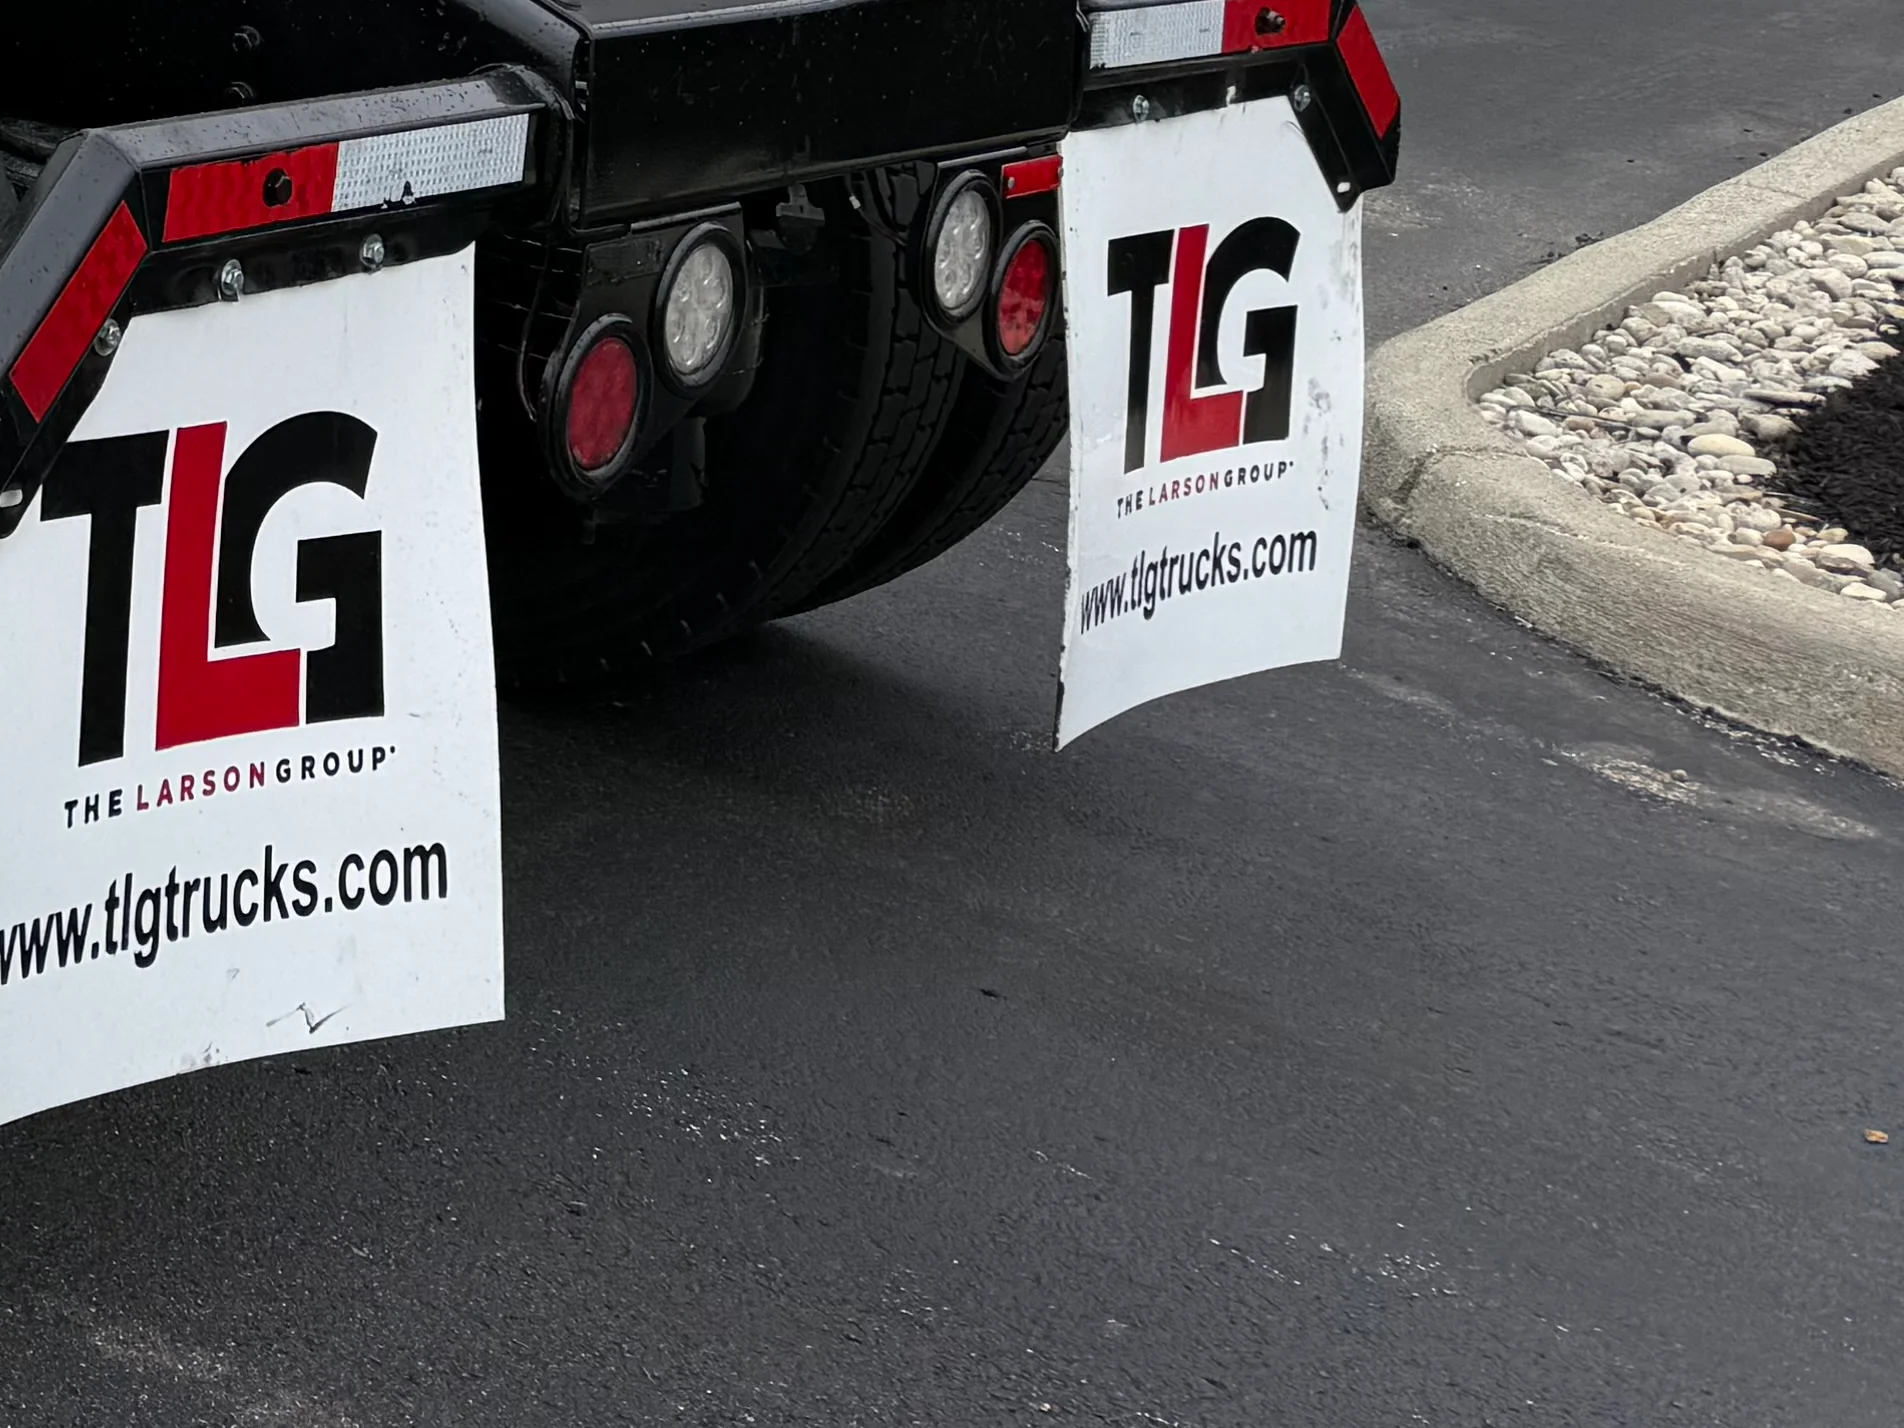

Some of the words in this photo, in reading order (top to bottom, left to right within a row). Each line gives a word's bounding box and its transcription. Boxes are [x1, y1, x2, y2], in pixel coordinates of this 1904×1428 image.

[1106, 215, 1301, 476] TLG
[1116, 489, 1144, 520] THE
[39, 409, 385, 767] TLG
[1079, 528, 1318, 636] www.tlgtrucks.com
[64, 788, 123, 829] THE
